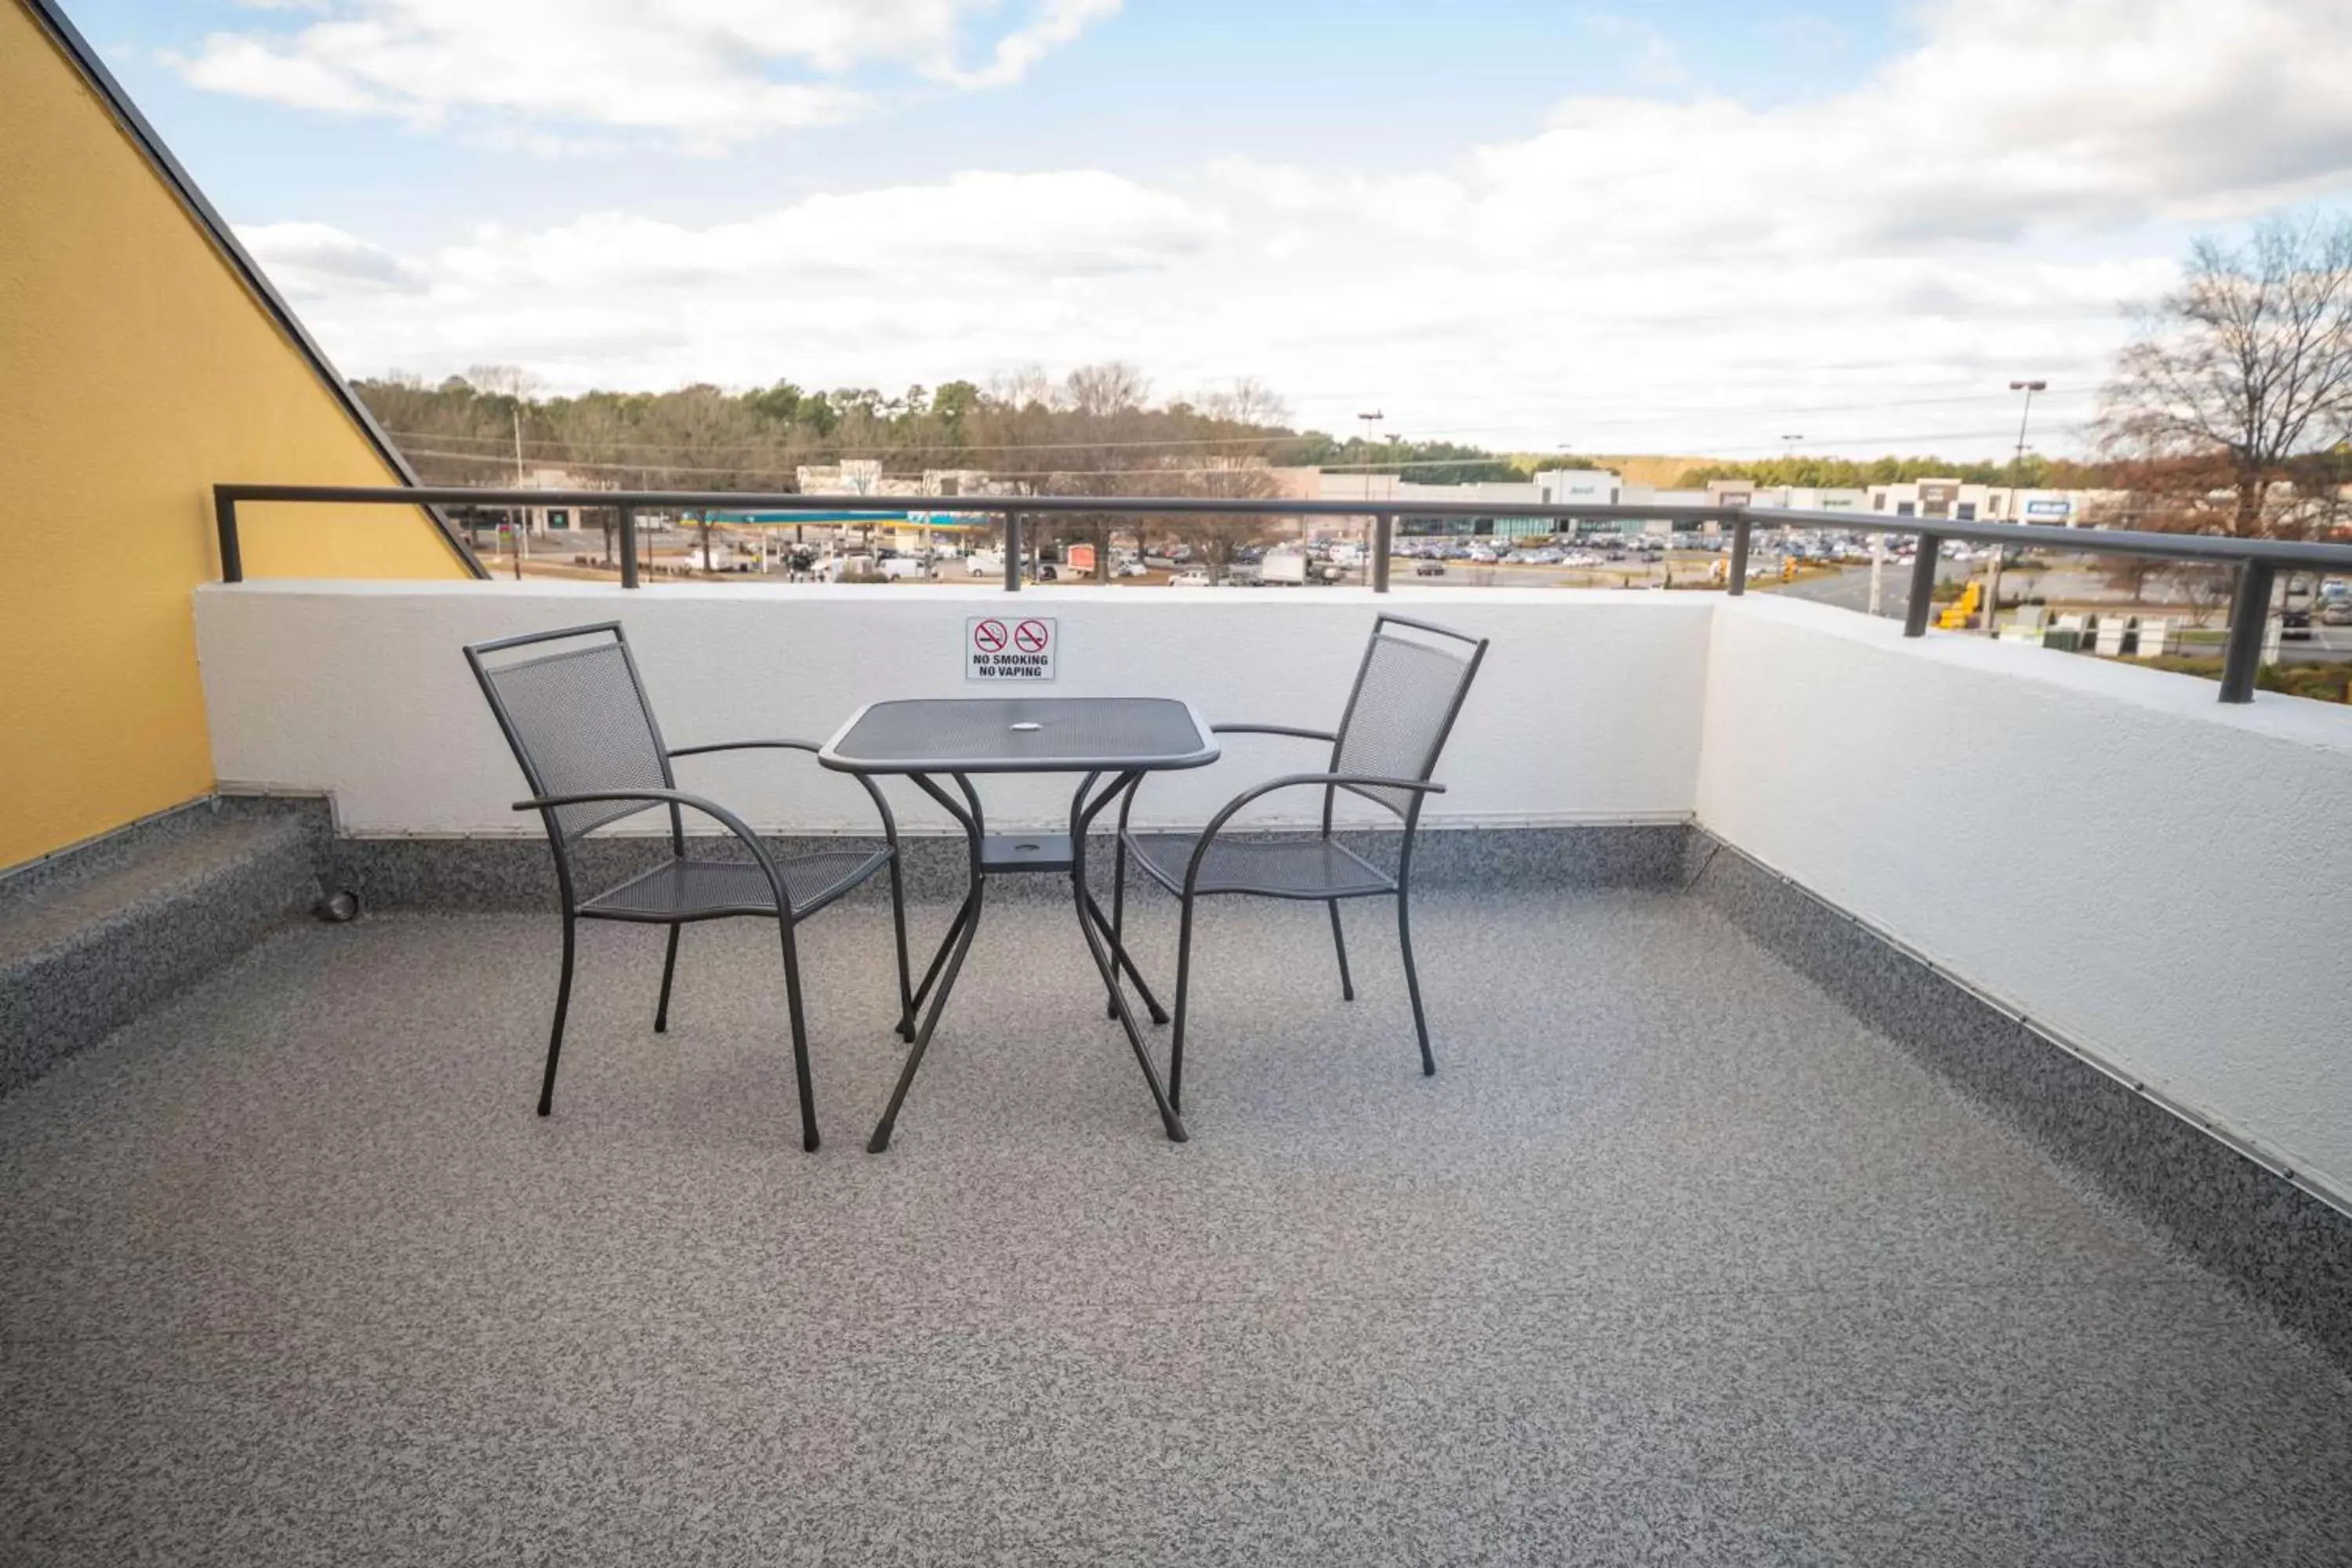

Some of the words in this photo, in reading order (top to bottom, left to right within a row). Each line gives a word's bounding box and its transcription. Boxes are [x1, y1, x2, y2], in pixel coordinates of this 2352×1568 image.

[973, 655, 989, 665] NO
[993, 655, 1047, 665] SMOKING
[979, 666, 995, 677] NO
[998, 666, 1042, 677] VAPING
